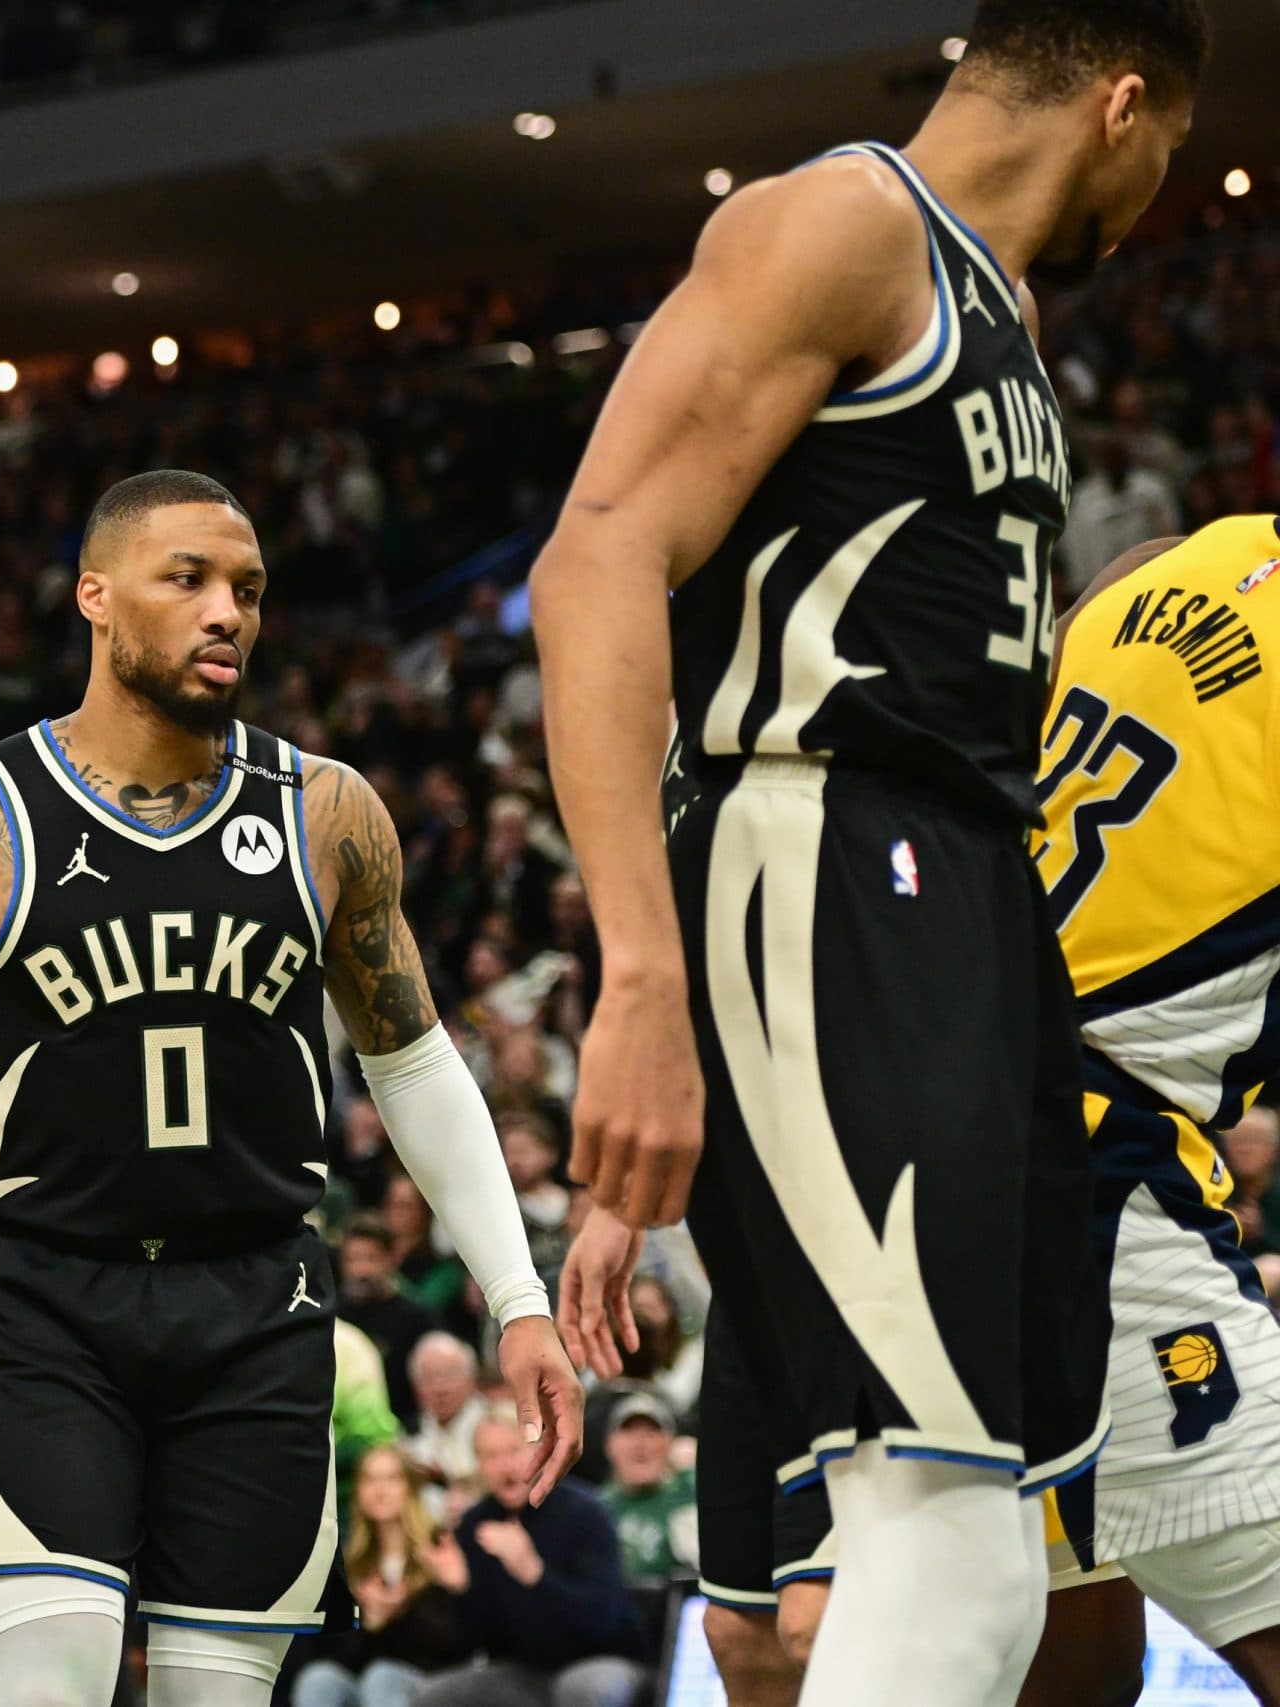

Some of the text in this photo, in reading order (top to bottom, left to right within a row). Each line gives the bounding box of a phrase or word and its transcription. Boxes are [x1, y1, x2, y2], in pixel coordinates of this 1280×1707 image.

[952, 376, 1072, 516] BUCK
[1111, 587, 1263, 704] NESMITH
[232, 757, 295, 785] BRIDGEMAN
[21, 911, 309, 1026] BUCKS
[141, 1023, 211, 1150] 0
